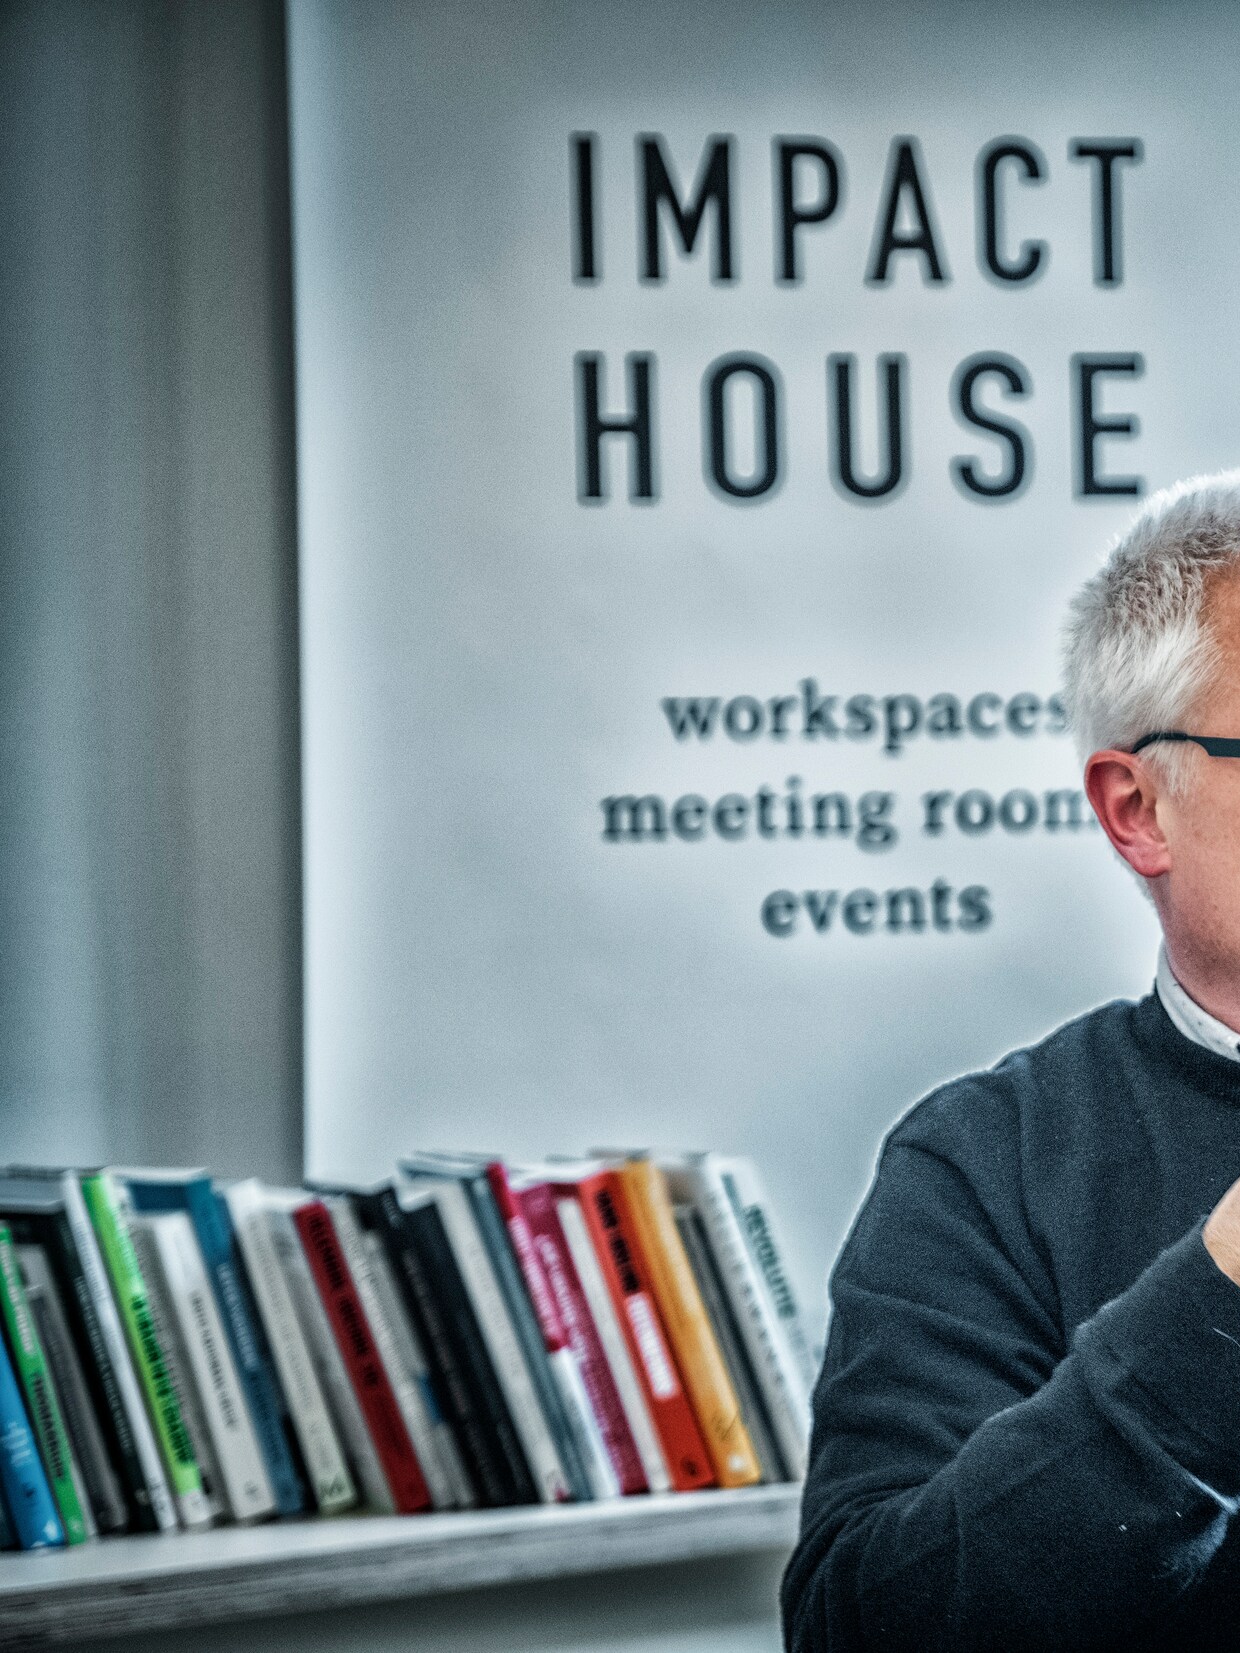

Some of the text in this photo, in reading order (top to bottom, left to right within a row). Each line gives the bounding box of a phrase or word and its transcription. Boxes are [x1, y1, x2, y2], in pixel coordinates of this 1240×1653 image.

[571, 133, 1141, 286] IMPACT
[575, 353, 1142, 502] HOUSE
[661, 677, 1068, 757] workspaces
[601, 774, 1099, 854] meeting room
[760, 877, 993, 937] events
